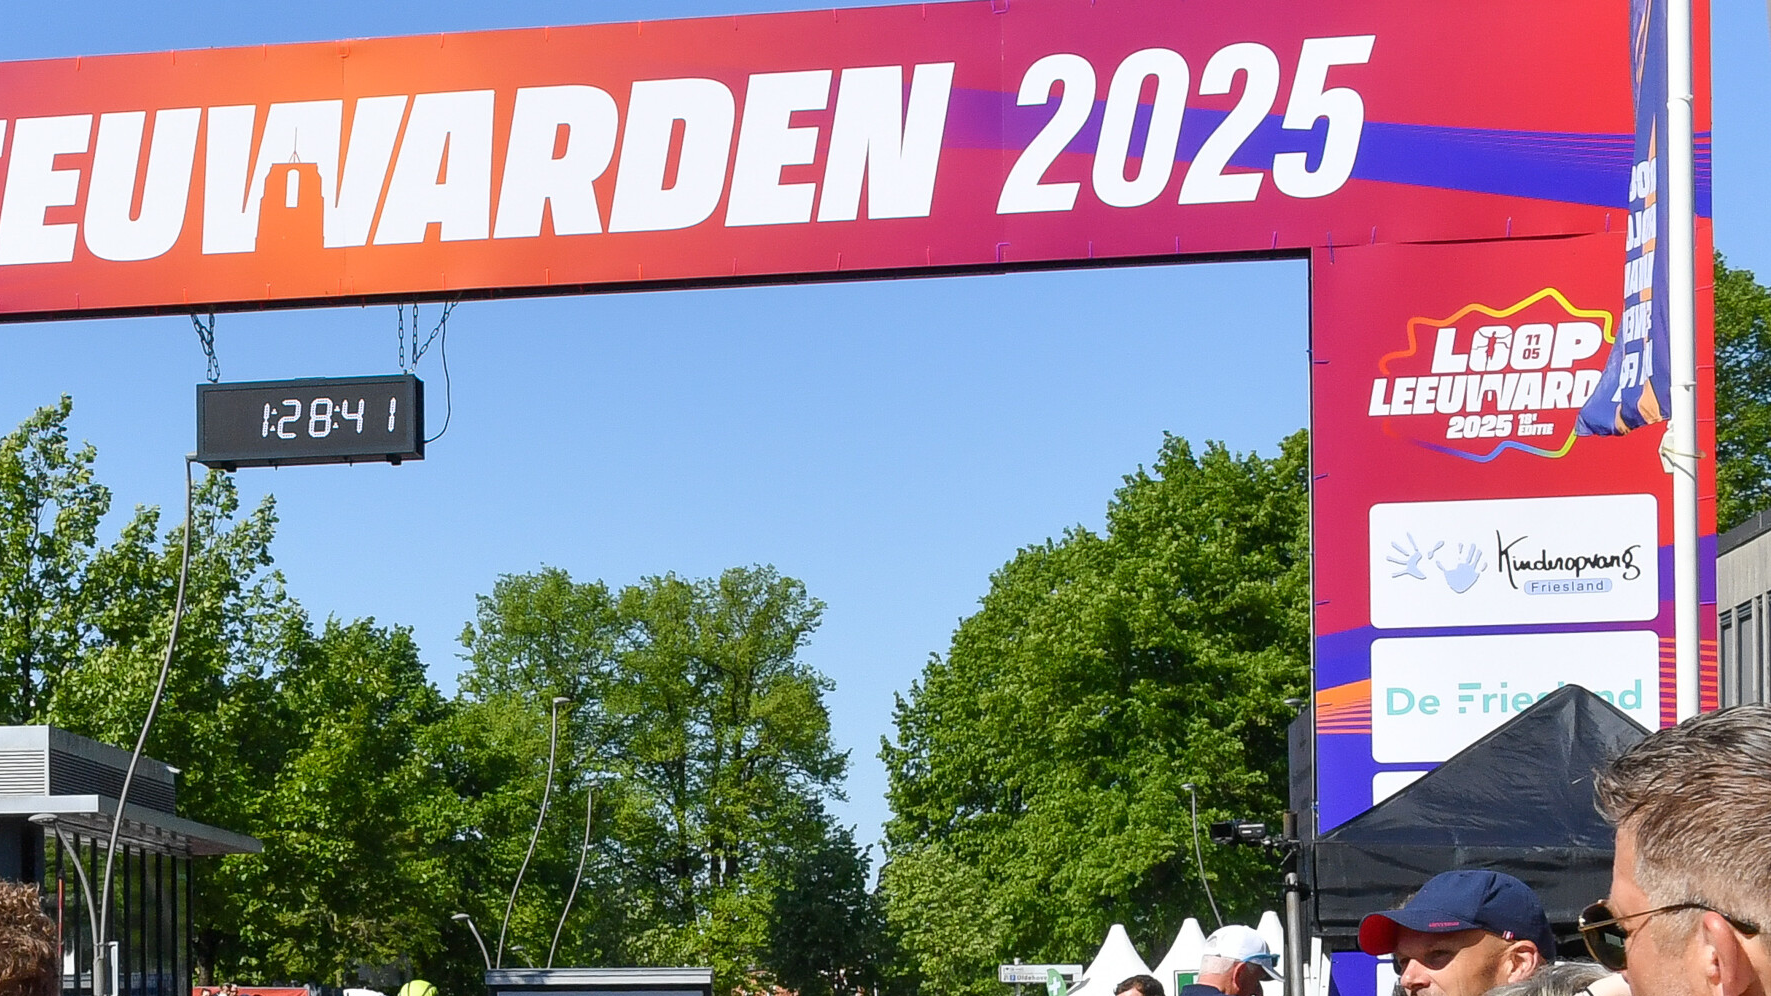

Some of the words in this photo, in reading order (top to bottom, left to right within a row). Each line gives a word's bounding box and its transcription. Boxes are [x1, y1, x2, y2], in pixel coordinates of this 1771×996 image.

[996, 34, 1375, 215] 2025
[1431, 321, 1603, 374] LOOP
[1368, 369, 1604, 417] LEEUWARD
[261, 397, 397, 440] 1:28:41
[1446, 413, 1514, 439] 2025
[1495, 530, 1642, 590] Kinderopvang
[1531, 580, 1604, 592] Friesland
[1386, 687, 1440, 716] De
[1458, 679, 1643, 715] Friesnd
